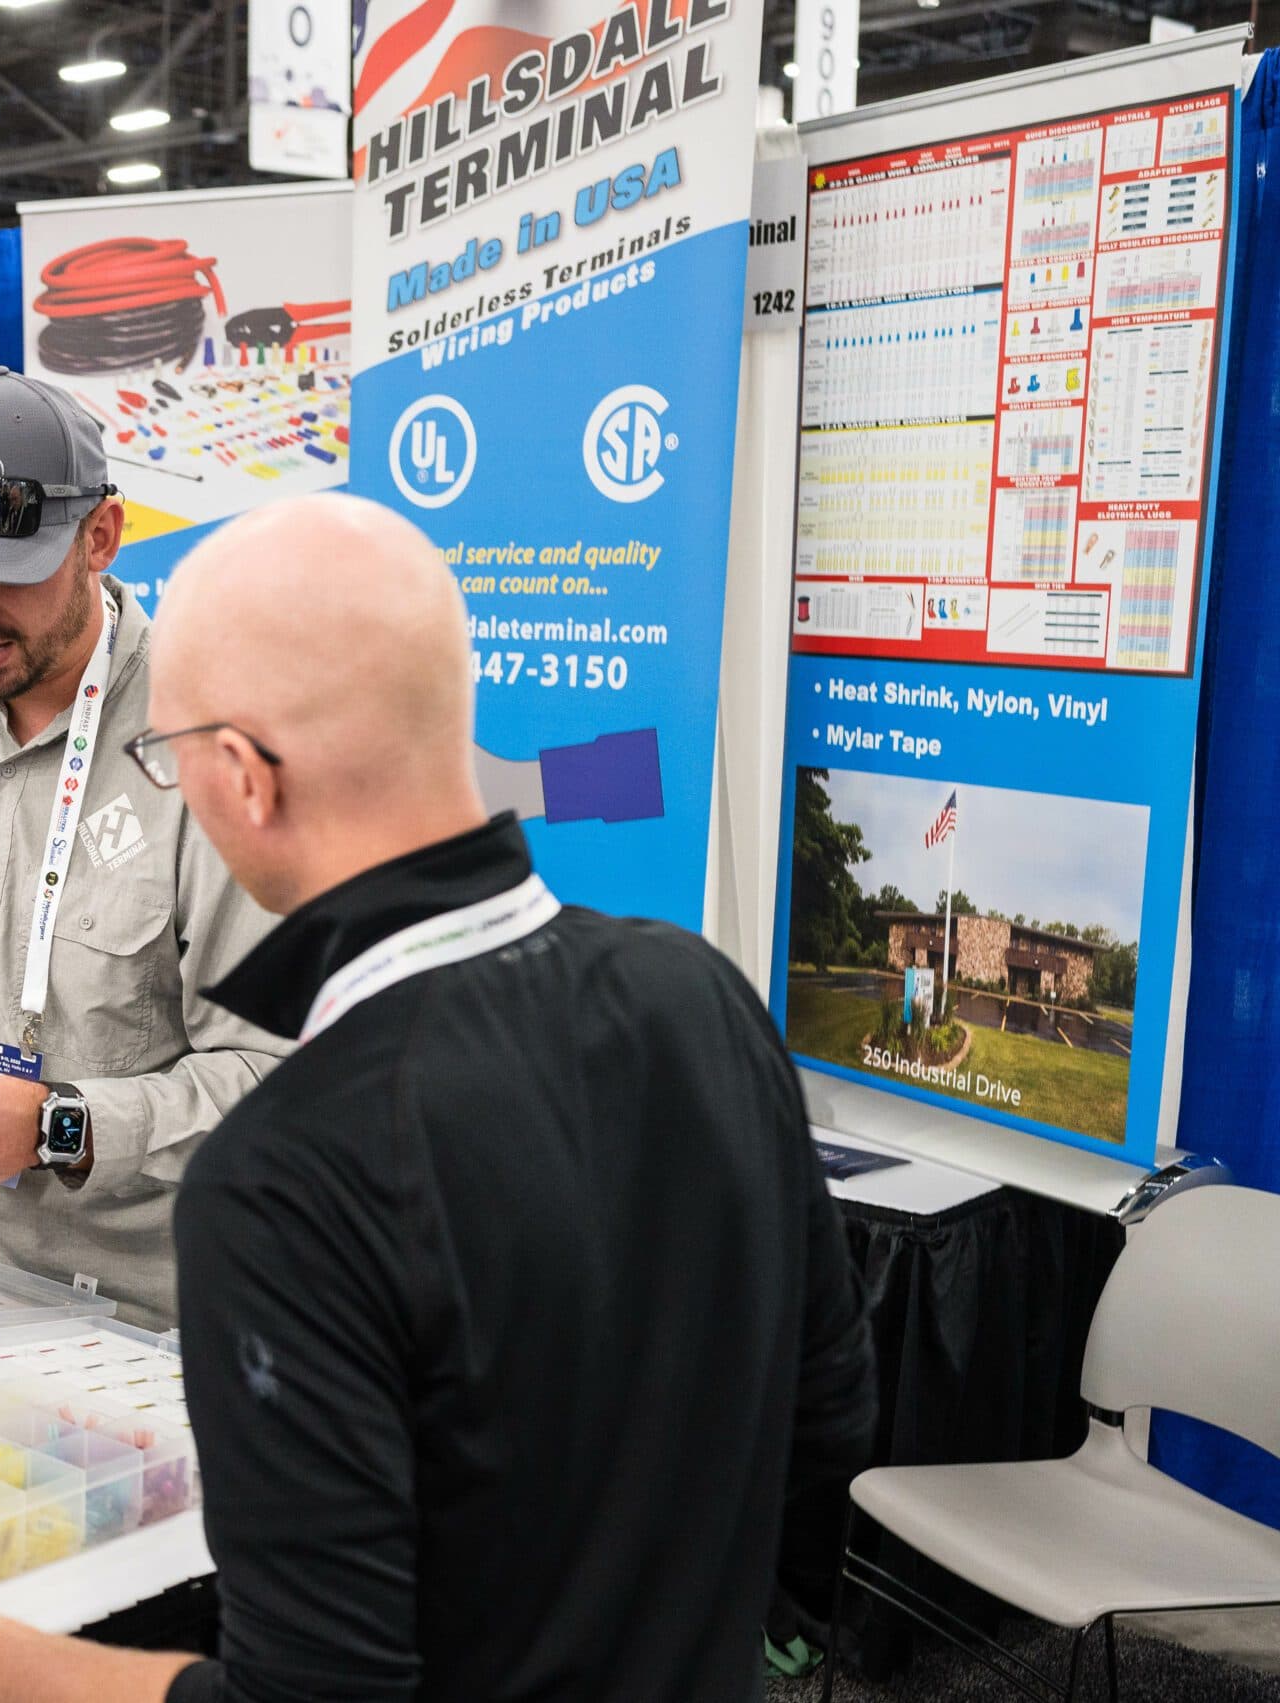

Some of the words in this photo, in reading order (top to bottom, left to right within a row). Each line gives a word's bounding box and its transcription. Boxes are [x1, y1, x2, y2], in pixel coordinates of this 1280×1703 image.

[1114, 111, 1151, 124] PIGTAILS
[1169, 103, 1194, 115] NYLON
[1196, 97, 1221, 110] FLAGS
[385, 43, 719, 237] TERMINAL
[1049, 120, 1100, 137] DISCONNECTS
[855, 171, 887, 184] GAUGE
[887, 166, 912, 178] WIRE
[913, 154, 979, 174] CONNECTORS
[1138, 166, 1182, 179] ADAPTERS
[387, 237, 503, 313] Made
[518, 211, 561, 255] in
[574, 146, 682, 227] USA
[1098, 241, 1118, 252] FULLY
[1120, 236, 1161, 249] INSULATED
[1163, 231, 1220, 244] DISCONNECTS
[388, 282, 533, 353] Solderless
[543, 214, 692, 290] Terminals
[853, 297, 882, 307] GAUGE
[884, 293, 907, 304] WIRE
[909, 287, 974, 301] CONNECTORS
[420, 317, 513, 371] Wiring
[521, 260, 656, 331] Products
[753, 289, 795, 316] 1242
[1111, 316, 1130, 326] HIGH
[1132, 312, 1190, 323] TEMPERATURE
[411, 420, 455, 483] UL
[1097, 512, 1146, 520] ELECTRICAL
[1148, 511, 1171, 519] LUGS
[1108, 503, 1134, 512] HEAVY
[1136, 503, 1160, 511] DUTY
[466, 542, 535, 565] service
[539, 541, 581, 565] and
[585, 540, 661, 571] quality
[462, 576, 495, 595] can
[500, 574, 559, 595] count
[562, 576, 608, 595] on...
[829, 678, 878, 704] Heat
[884, 681, 959, 713] Shrink,
[967, 688, 1040, 721] Nylon,
[1048, 693, 1107, 726] Vinyl
[826, 724, 883, 752] Mylar
[890, 729, 942, 759] Tape
[77, 821, 103, 869] HILLSDALE
[106, 838, 147, 871] TERMINAL
[863, 1044, 891, 1070] 250
[895, 1053, 971, 1093] Industrial
[976, 1075, 1022, 1106] Drive
